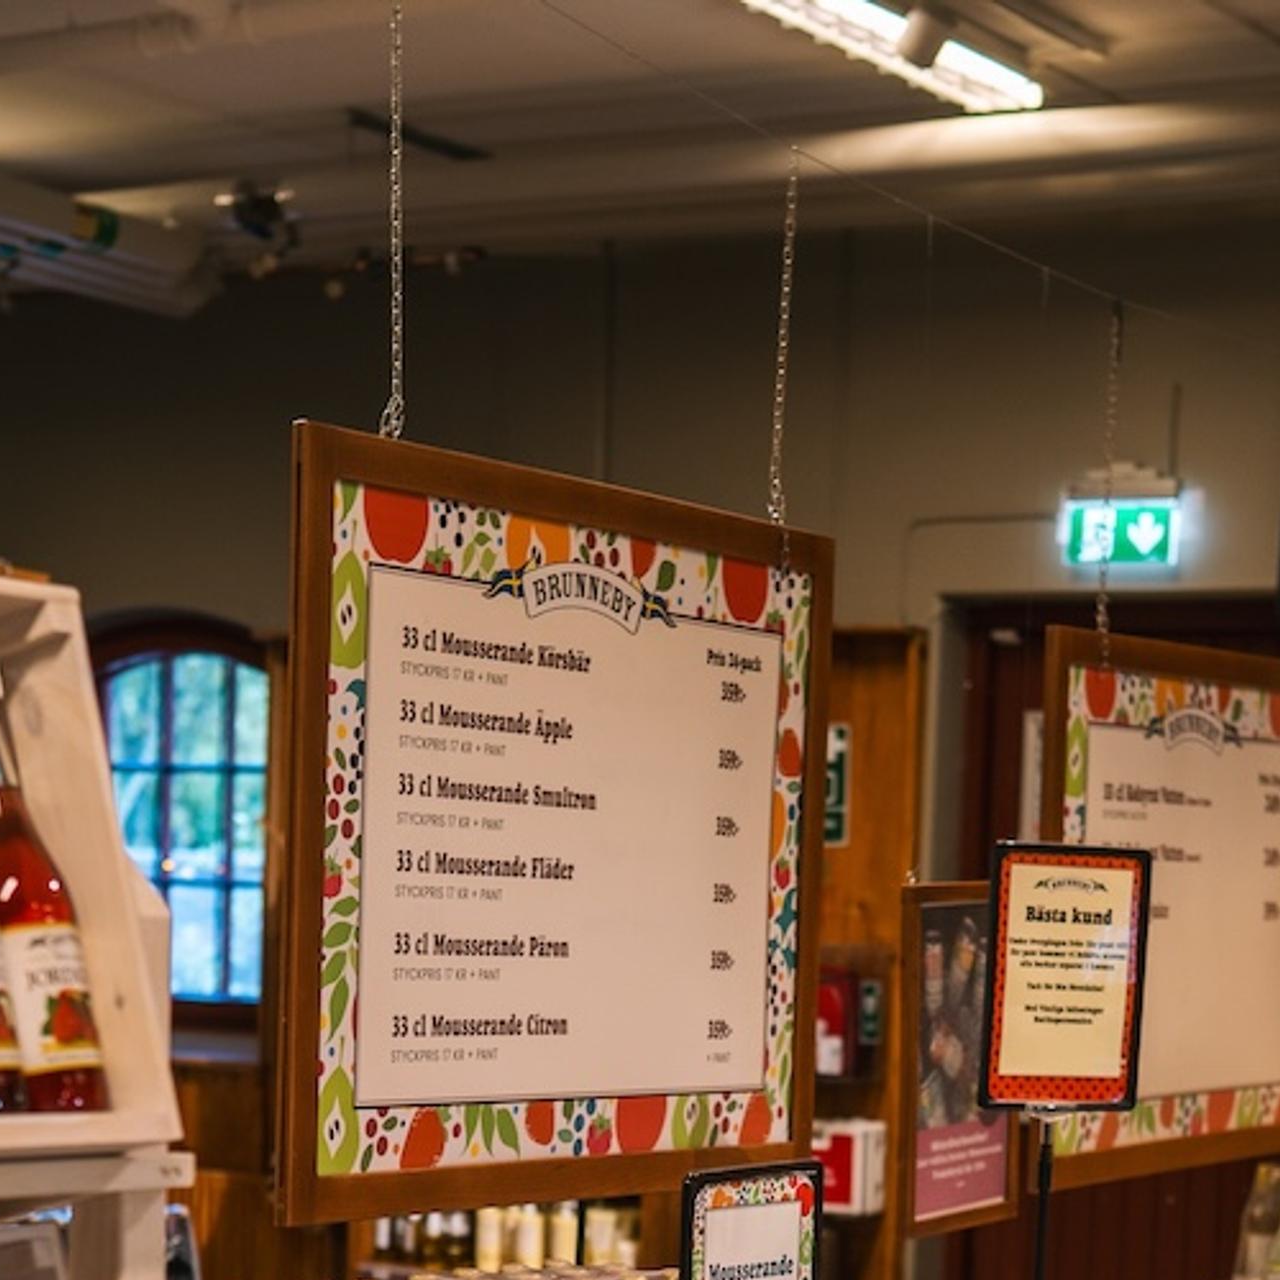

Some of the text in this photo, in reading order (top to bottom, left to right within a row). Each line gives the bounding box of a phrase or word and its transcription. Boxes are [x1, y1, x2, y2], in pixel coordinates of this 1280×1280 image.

[532, 571, 637, 621] BRUNNEBY
[401, 626, 419, 649] 33
[423, 629, 436, 651] cl
[441, 632, 533, 666] Mousserande
[486, 672, 509, 686] PANT
[399, 699, 573, 745] 33 cl Mousserande Äpple
[483, 743, 507, 757] PANT
[398, 772, 598, 811] 33 cl Mousserande Smultron
[481, 817, 505, 831] PANT
[396, 849, 575, 881] 33 cl Mousserande Fläder
[479, 888, 503, 902] PANT
[1025, 906, 1113, 926] Bästa kund
[393, 931, 570, 959] 33 cl Mousserande Päron
[478, 967, 501, 982] PANT
[391, 1012, 568, 1038] 33 cl Mousserande Citron
[476, 1047, 499, 1062] PANT
